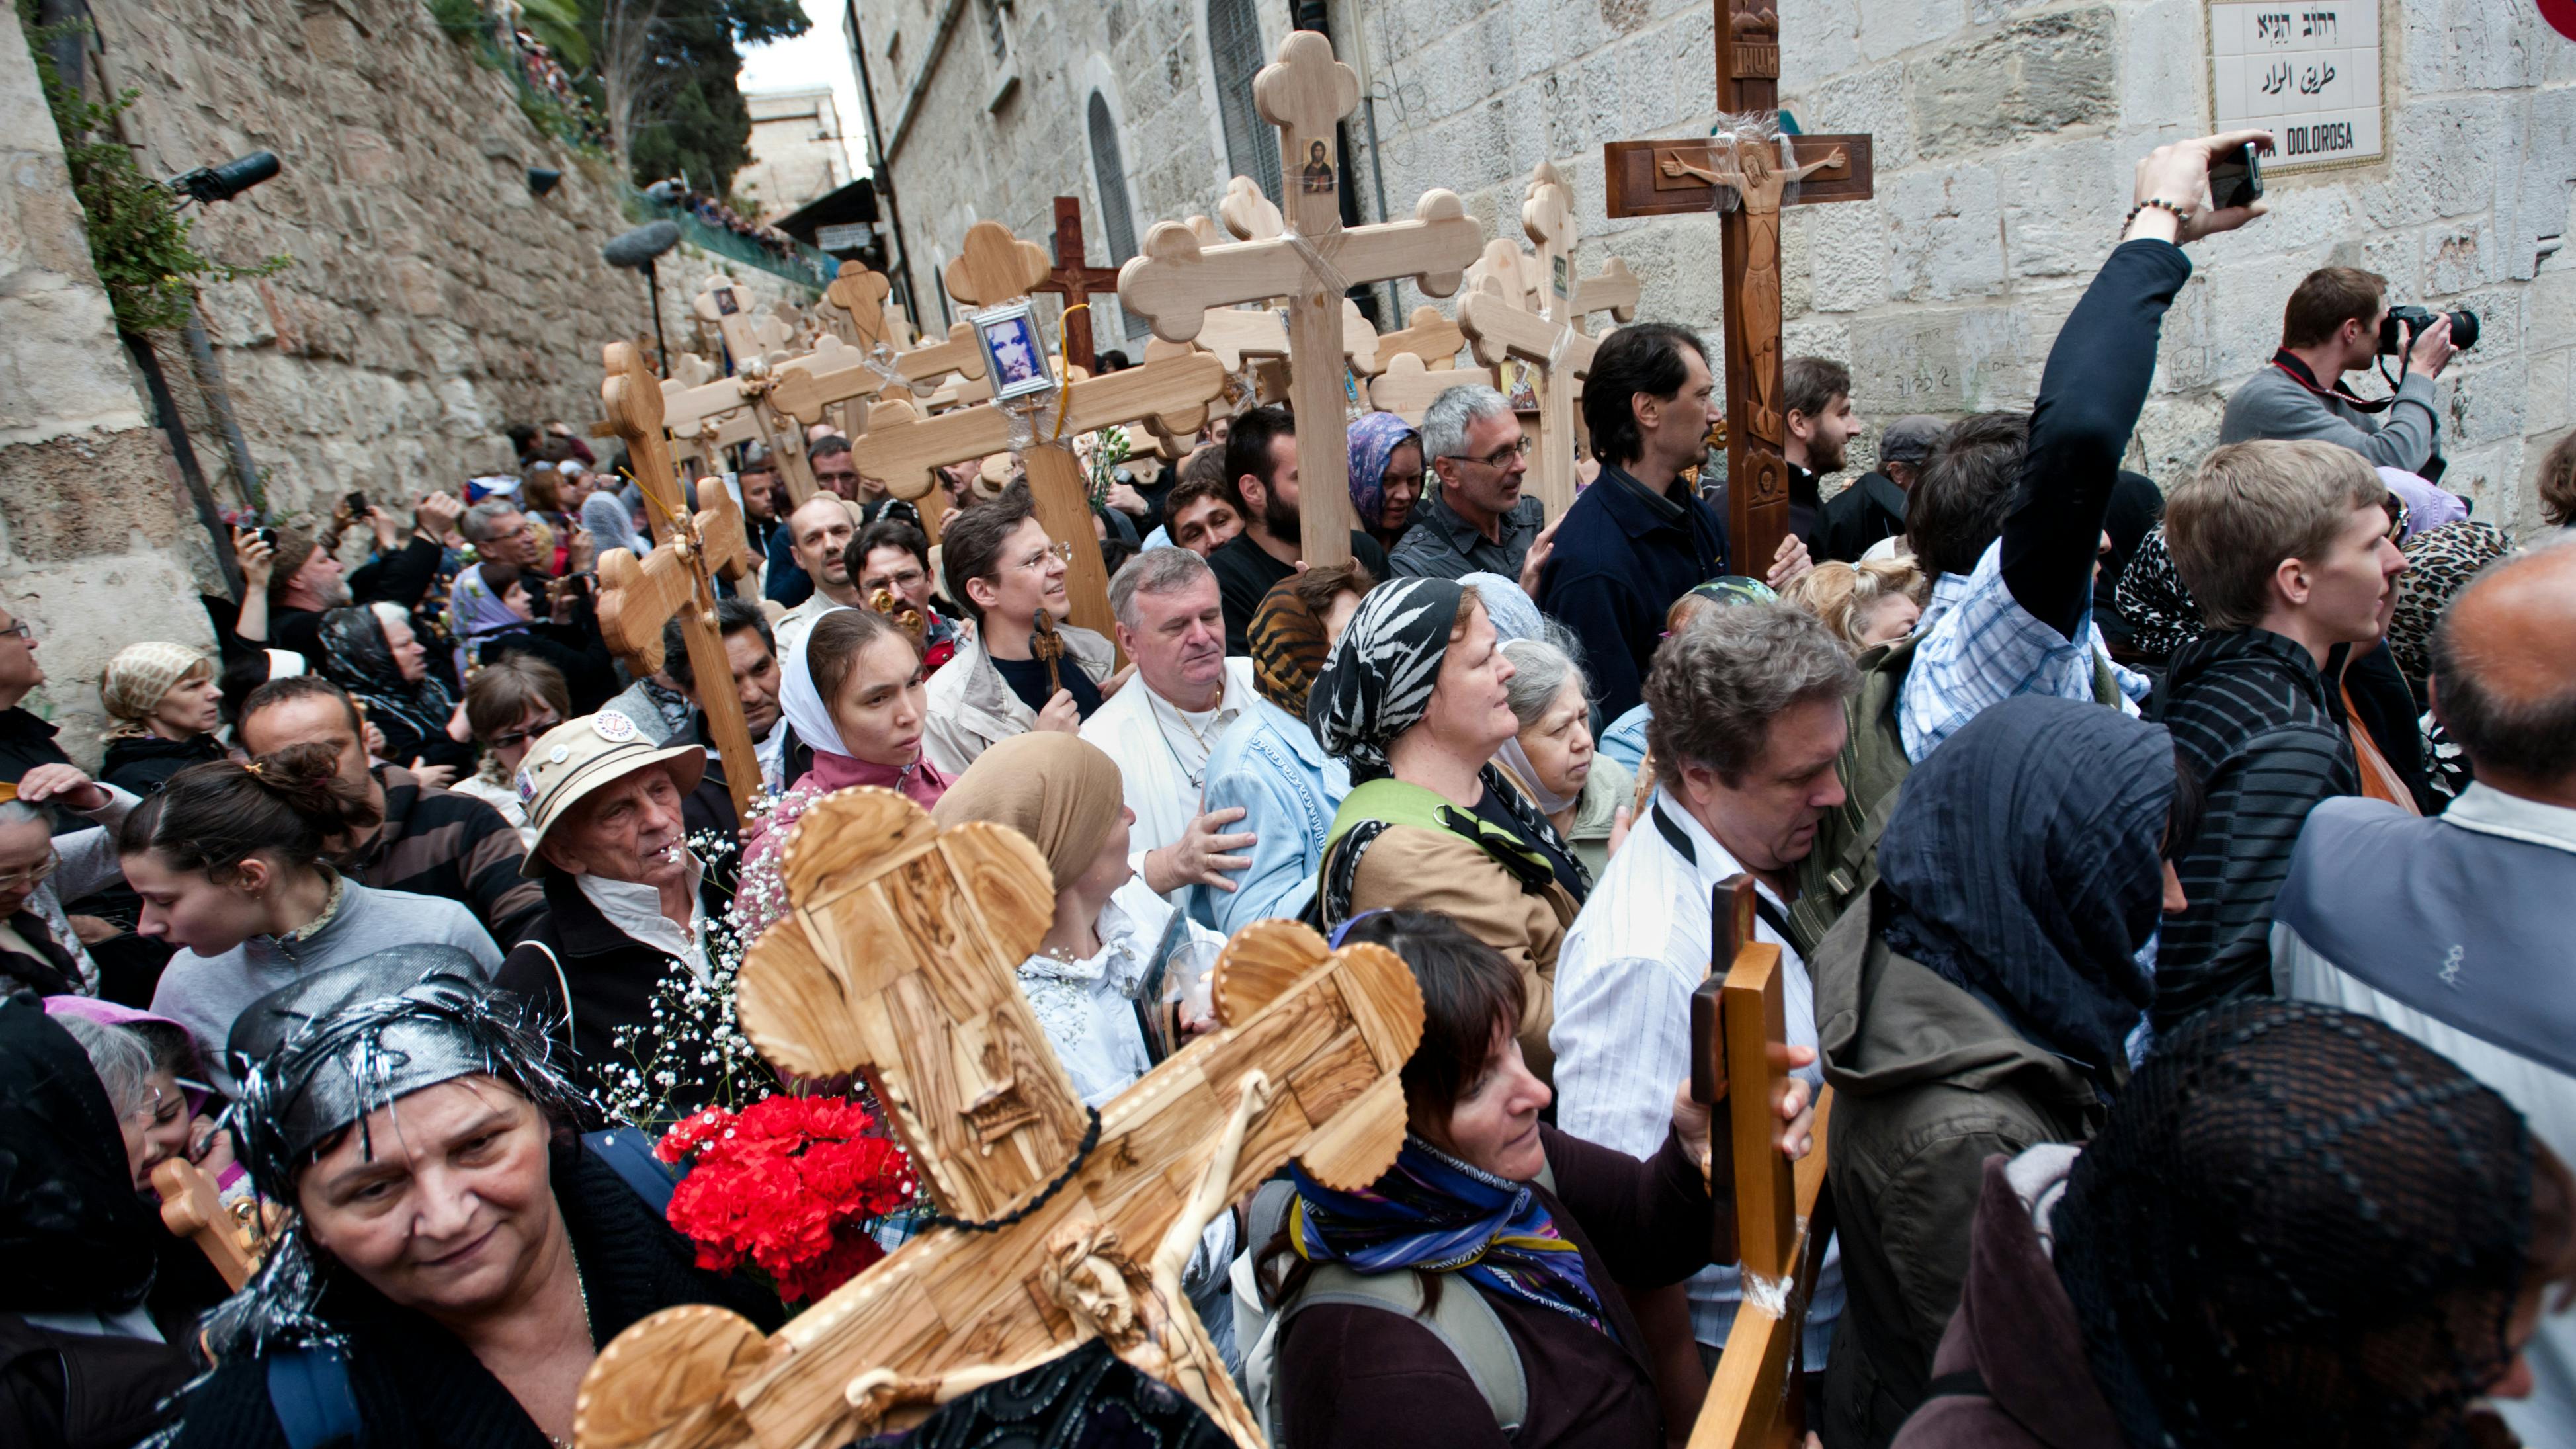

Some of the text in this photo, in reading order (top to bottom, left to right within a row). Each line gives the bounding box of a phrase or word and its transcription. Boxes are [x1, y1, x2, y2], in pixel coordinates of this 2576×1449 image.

[2261, 60, 2336, 95] طريق الواد
[2287, 122, 2354, 156] DOLOROSA
